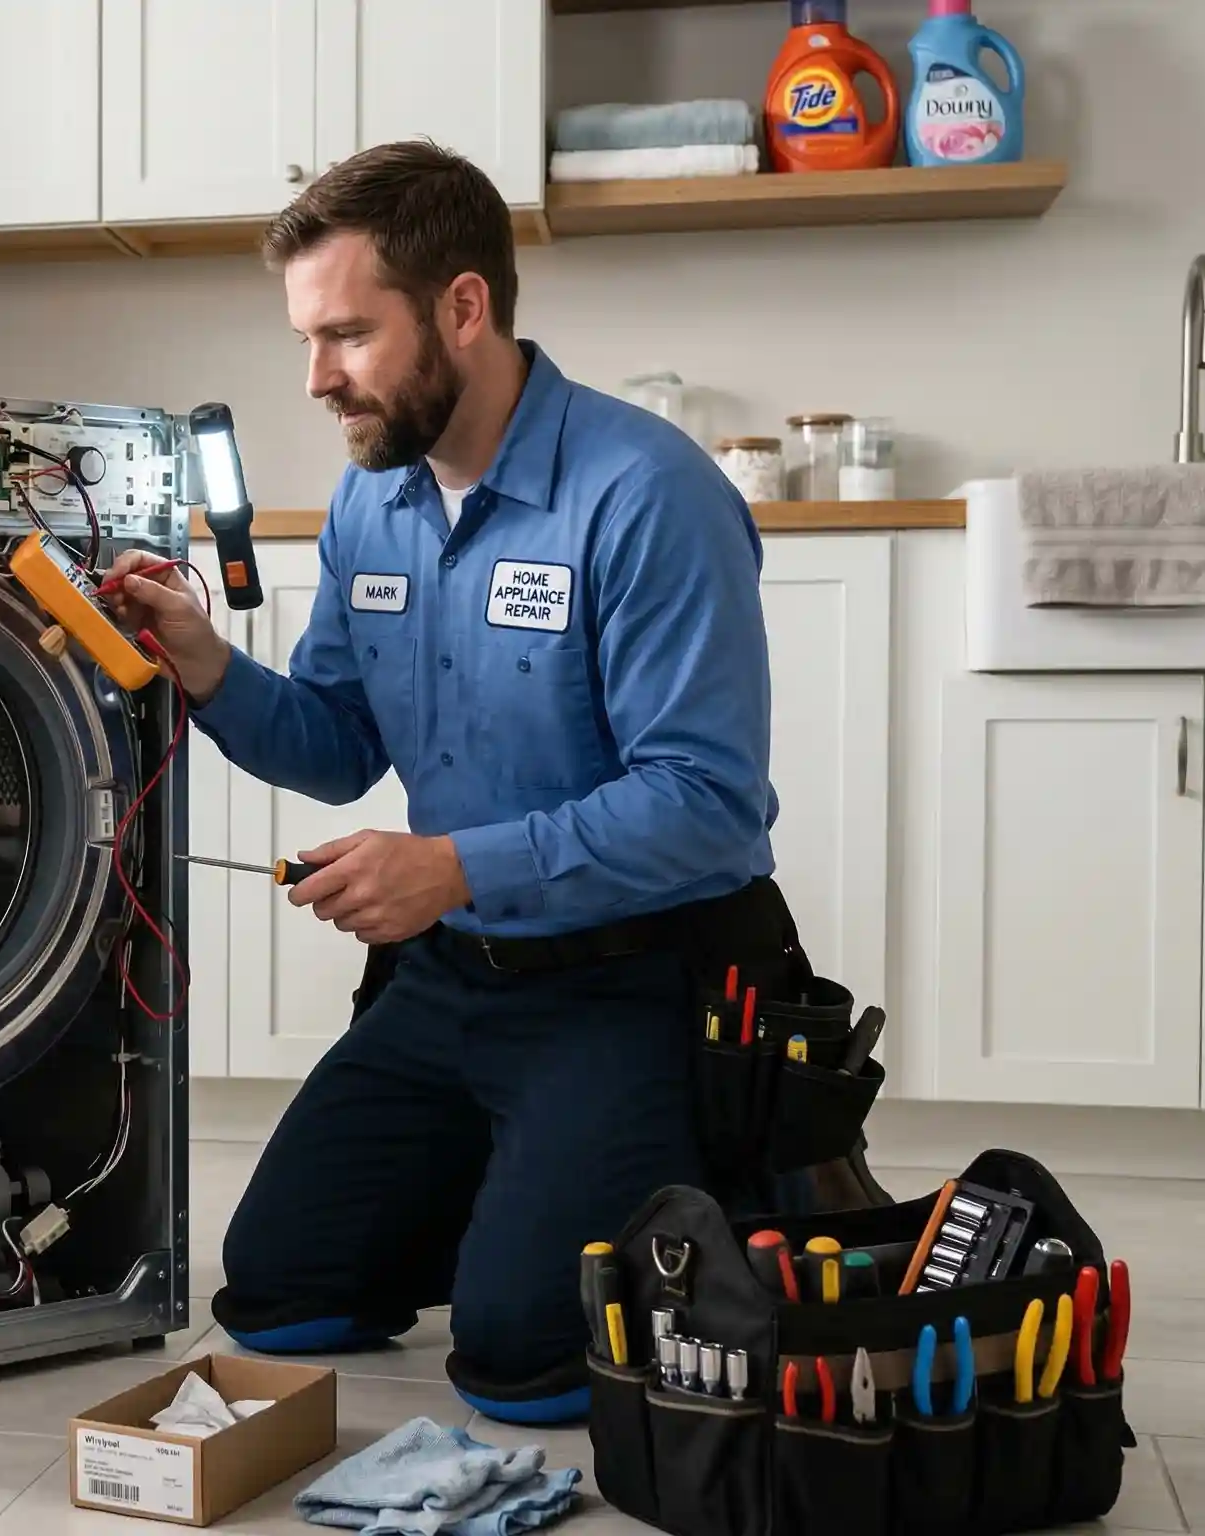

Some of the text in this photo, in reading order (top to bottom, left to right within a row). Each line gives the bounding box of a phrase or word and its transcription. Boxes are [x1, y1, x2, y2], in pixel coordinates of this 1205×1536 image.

[791, 84, 836, 117] Tide
[927, 99, 992, 119] Downy
[512, 570, 550, 587] HOME
[365, 585, 399, 600] MARK
[494, 586, 565, 605] APPLIANCE
[504, 604, 551, 621] REPAIR
